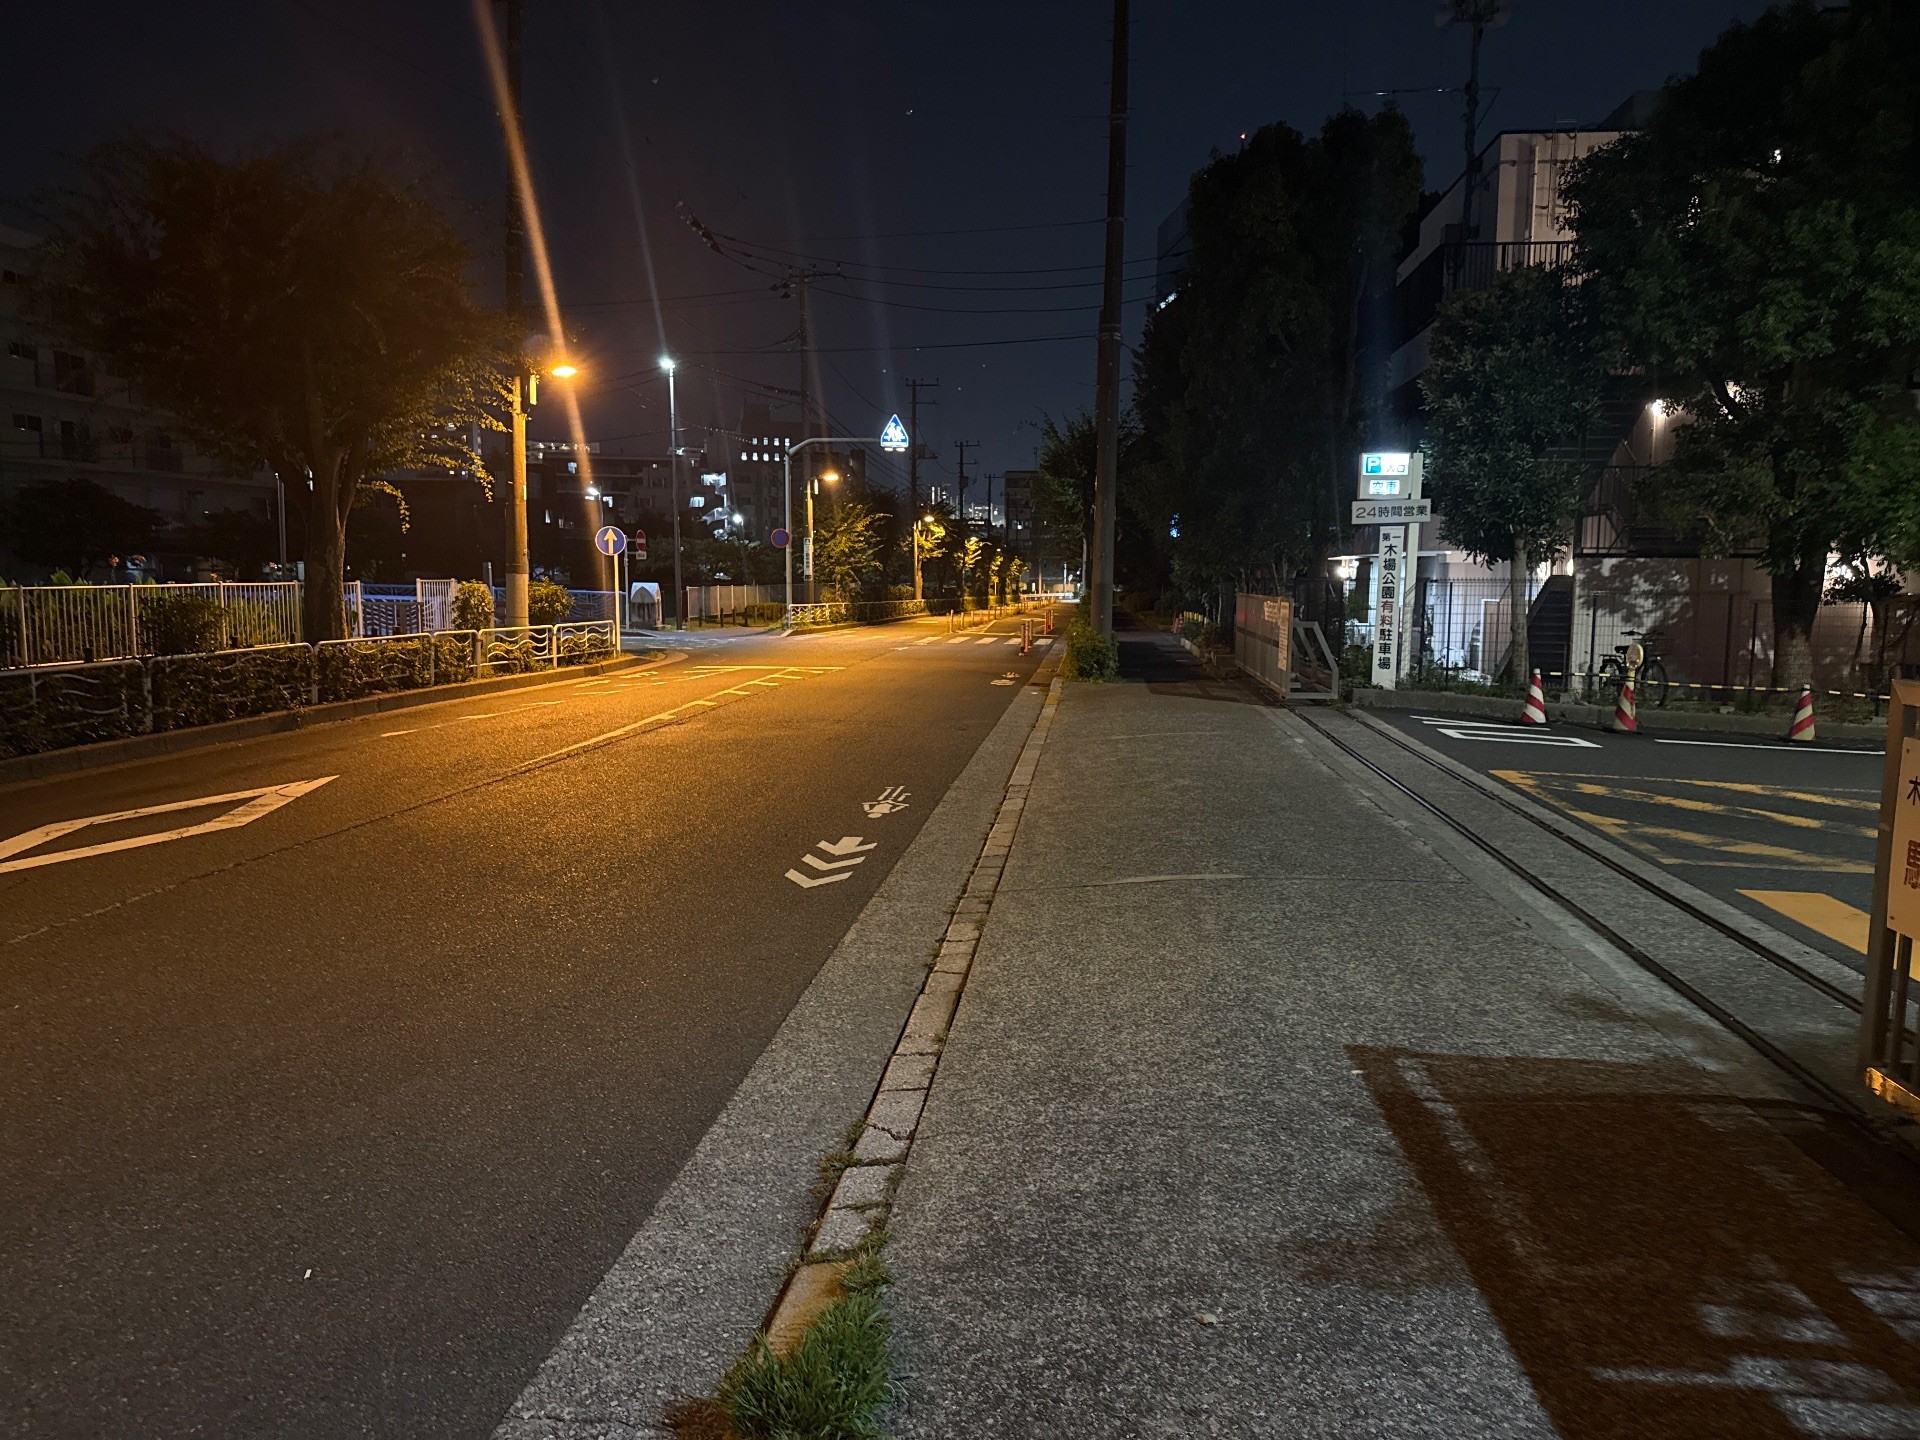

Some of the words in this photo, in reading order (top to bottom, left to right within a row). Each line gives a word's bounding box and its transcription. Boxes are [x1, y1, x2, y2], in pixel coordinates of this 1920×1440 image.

[1366, 457, 1380, 473] P
[1387, 465, 1405, 473] 入口
[1372, 481, 1397, 494] 空車
[1355, 505, 1428, 518] 24時間営業
